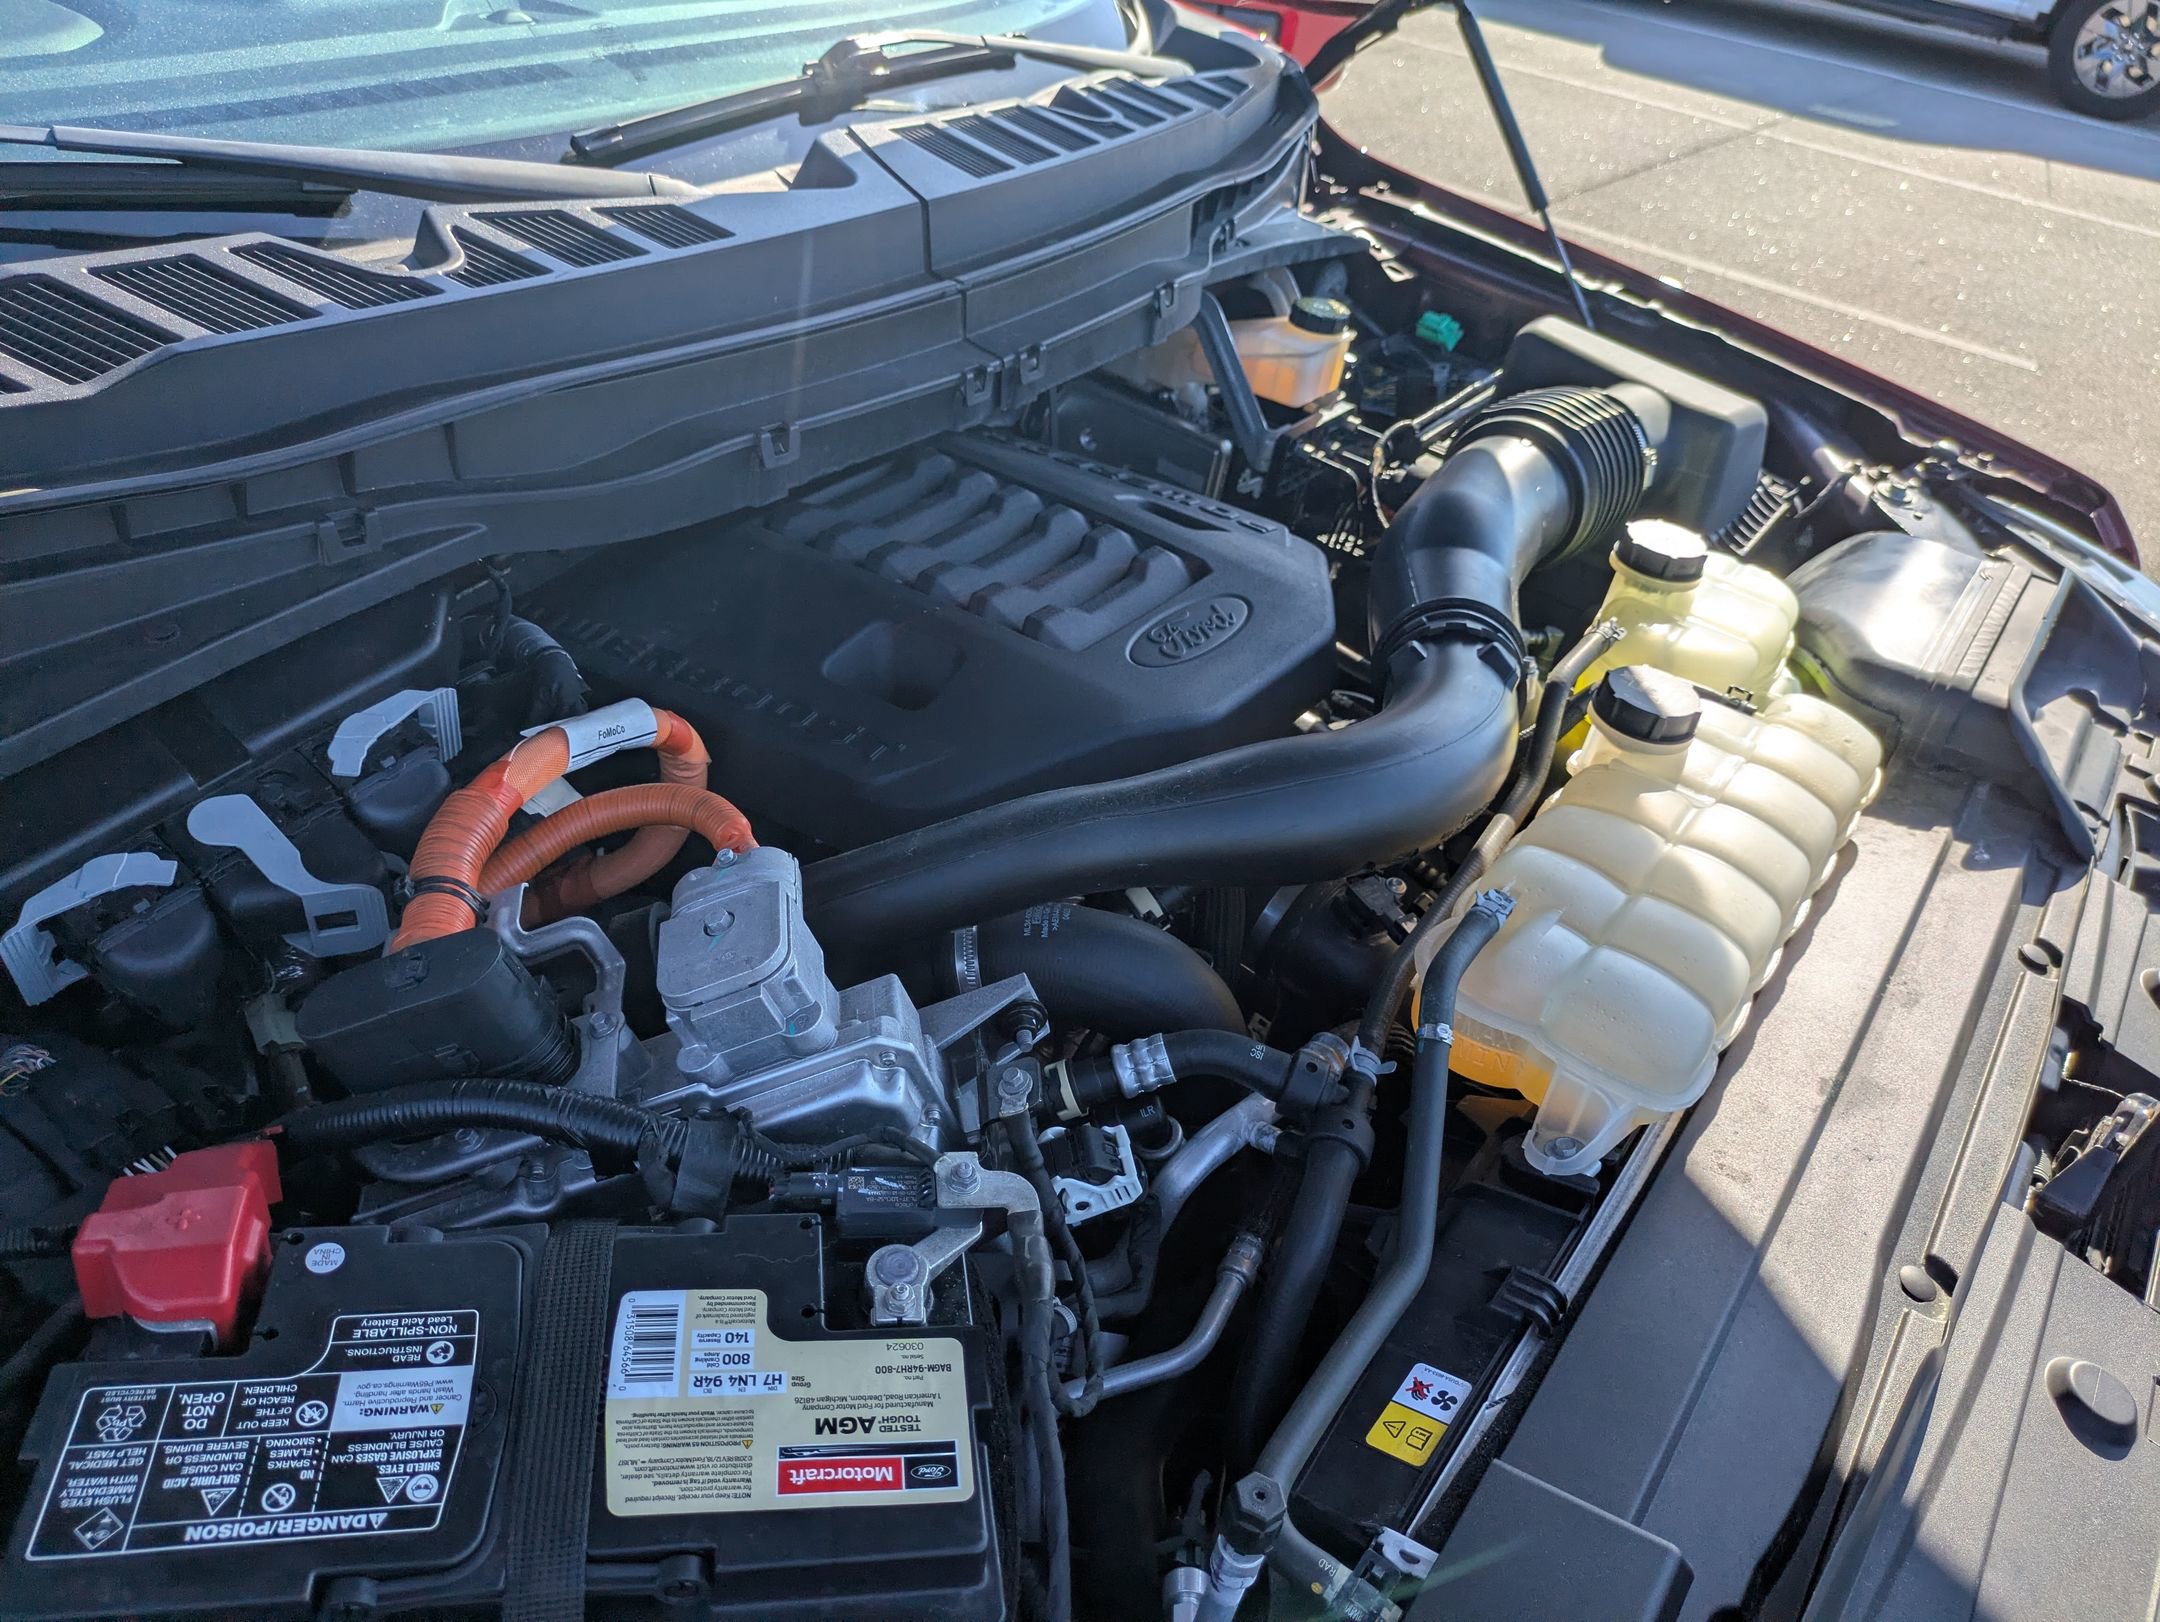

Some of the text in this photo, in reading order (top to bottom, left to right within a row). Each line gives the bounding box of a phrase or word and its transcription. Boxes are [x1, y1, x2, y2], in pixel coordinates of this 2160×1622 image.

[1146, 602, 1237, 660] Ford
[597, 724, 627, 741] FoMoCo
[1250, 1047, 1265, 1061] ISC
[314, 1247, 341, 1256] CHINA
[311, 1258, 338, 1267] MADE
[361, 1315, 453, 1328] Lead Acid Battery
[623, 1313, 636, 1341] 31508
[352, 1322, 458, 1339] NON-SPILLABLE
[725, 1331, 749, 1343] 140
[345, 1344, 423, 1357] INSTRUCTIONS.
[886, 1342, 924, 1351] 030624
[392, 1354, 421, 1362] READ
[620, 1346, 632, 1374] 64566
[722, 1353, 751, 1365] 800
[875, 1363, 951, 1374] BAGM-94RH7-800
[356, 1377, 453, 1391] www.P65Warnings.ca.gov
[693, 1374, 782, 1388] H7 LN4 94R
[104, 1389, 145, 1397] RECYCLED
[243, 1383, 298, 1395] CHILDREN.
[353, 1389, 388, 1399] handling.
[389, 1389, 406, 1397] after
[433, 1386, 454, 1394] Wash
[100, 1394, 157, 1404] BATTERY MUST
[179, 1391, 225, 1405] OPEN.
[240, 1395, 295, 1406] REACH OF
[367, 1395, 418, 1406] Reproductive
[435, 1394, 462, 1402] Cancer
[794, 1396, 815, 1404] 48126
[817, 1394, 847, 1403] Michigan
[848, 1394, 882, 1402] Dearborn,
[884, 1393, 903, 1401] Road,
[342, 1399, 366, 1408] Harm.
[802, 1402, 835, 1411] Company
[885, 1401, 933, 1409] Manufactured
[181, 1404, 216, 1417] NOT
[255, 1406, 292, 1416] OF THE
[359, 1404, 429, 1417] WARNING:
[112, 1418, 128, 1427] Pb
[183, 1417, 208, 1430] DO
[235, 1418, 290, 1429] KEEP OUT
[815, 1416, 876, 1435] AGM
[879, 1424, 921, 1433] TESTED
[389, 1429, 445, 1440] OR INJURY.
[163, 1440, 250, 1454] SEVERE BURNS.
[265, 1436, 315, 1447] SMOKING
[347, 1438, 444, 1453] CAUSE BLINDNESS
[85, 1447, 147, 1459] HELP FAST.
[164, 1451, 247, 1465] BLINDNESS OR
[269, 1447, 313, 1458] FLAMES
[331, 1448, 443, 1463] EXPLOSIVE GASES CAN
[68, 1457, 144, 1470] GET MEDICAL
[180, 1462, 244, 1474] CAN CAUSE
[267, 1458, 311, 1469] SPARKS
[376, 1460, 440, 1474] SHIELD EYES.
[300, 1469, 315, 1480] NO
[789, 1466, 893, 1485] Motorcraft
[918, 1466, 944, 1478] Ford
[65, 1474, 139, 1487] WITH WATER.
[162, 1473, 241, 1489] SULFURIC ACID
[58, 1484, 137, 1498] IMMEDIATELY
[59, 1494, 134, 1508] FLUSH EYES
[625, 1495, 651, 1503] required
[184, 1513, 368, 1540] DANGER/POISON
[1318, 1558, 1337, 1577] RAD
